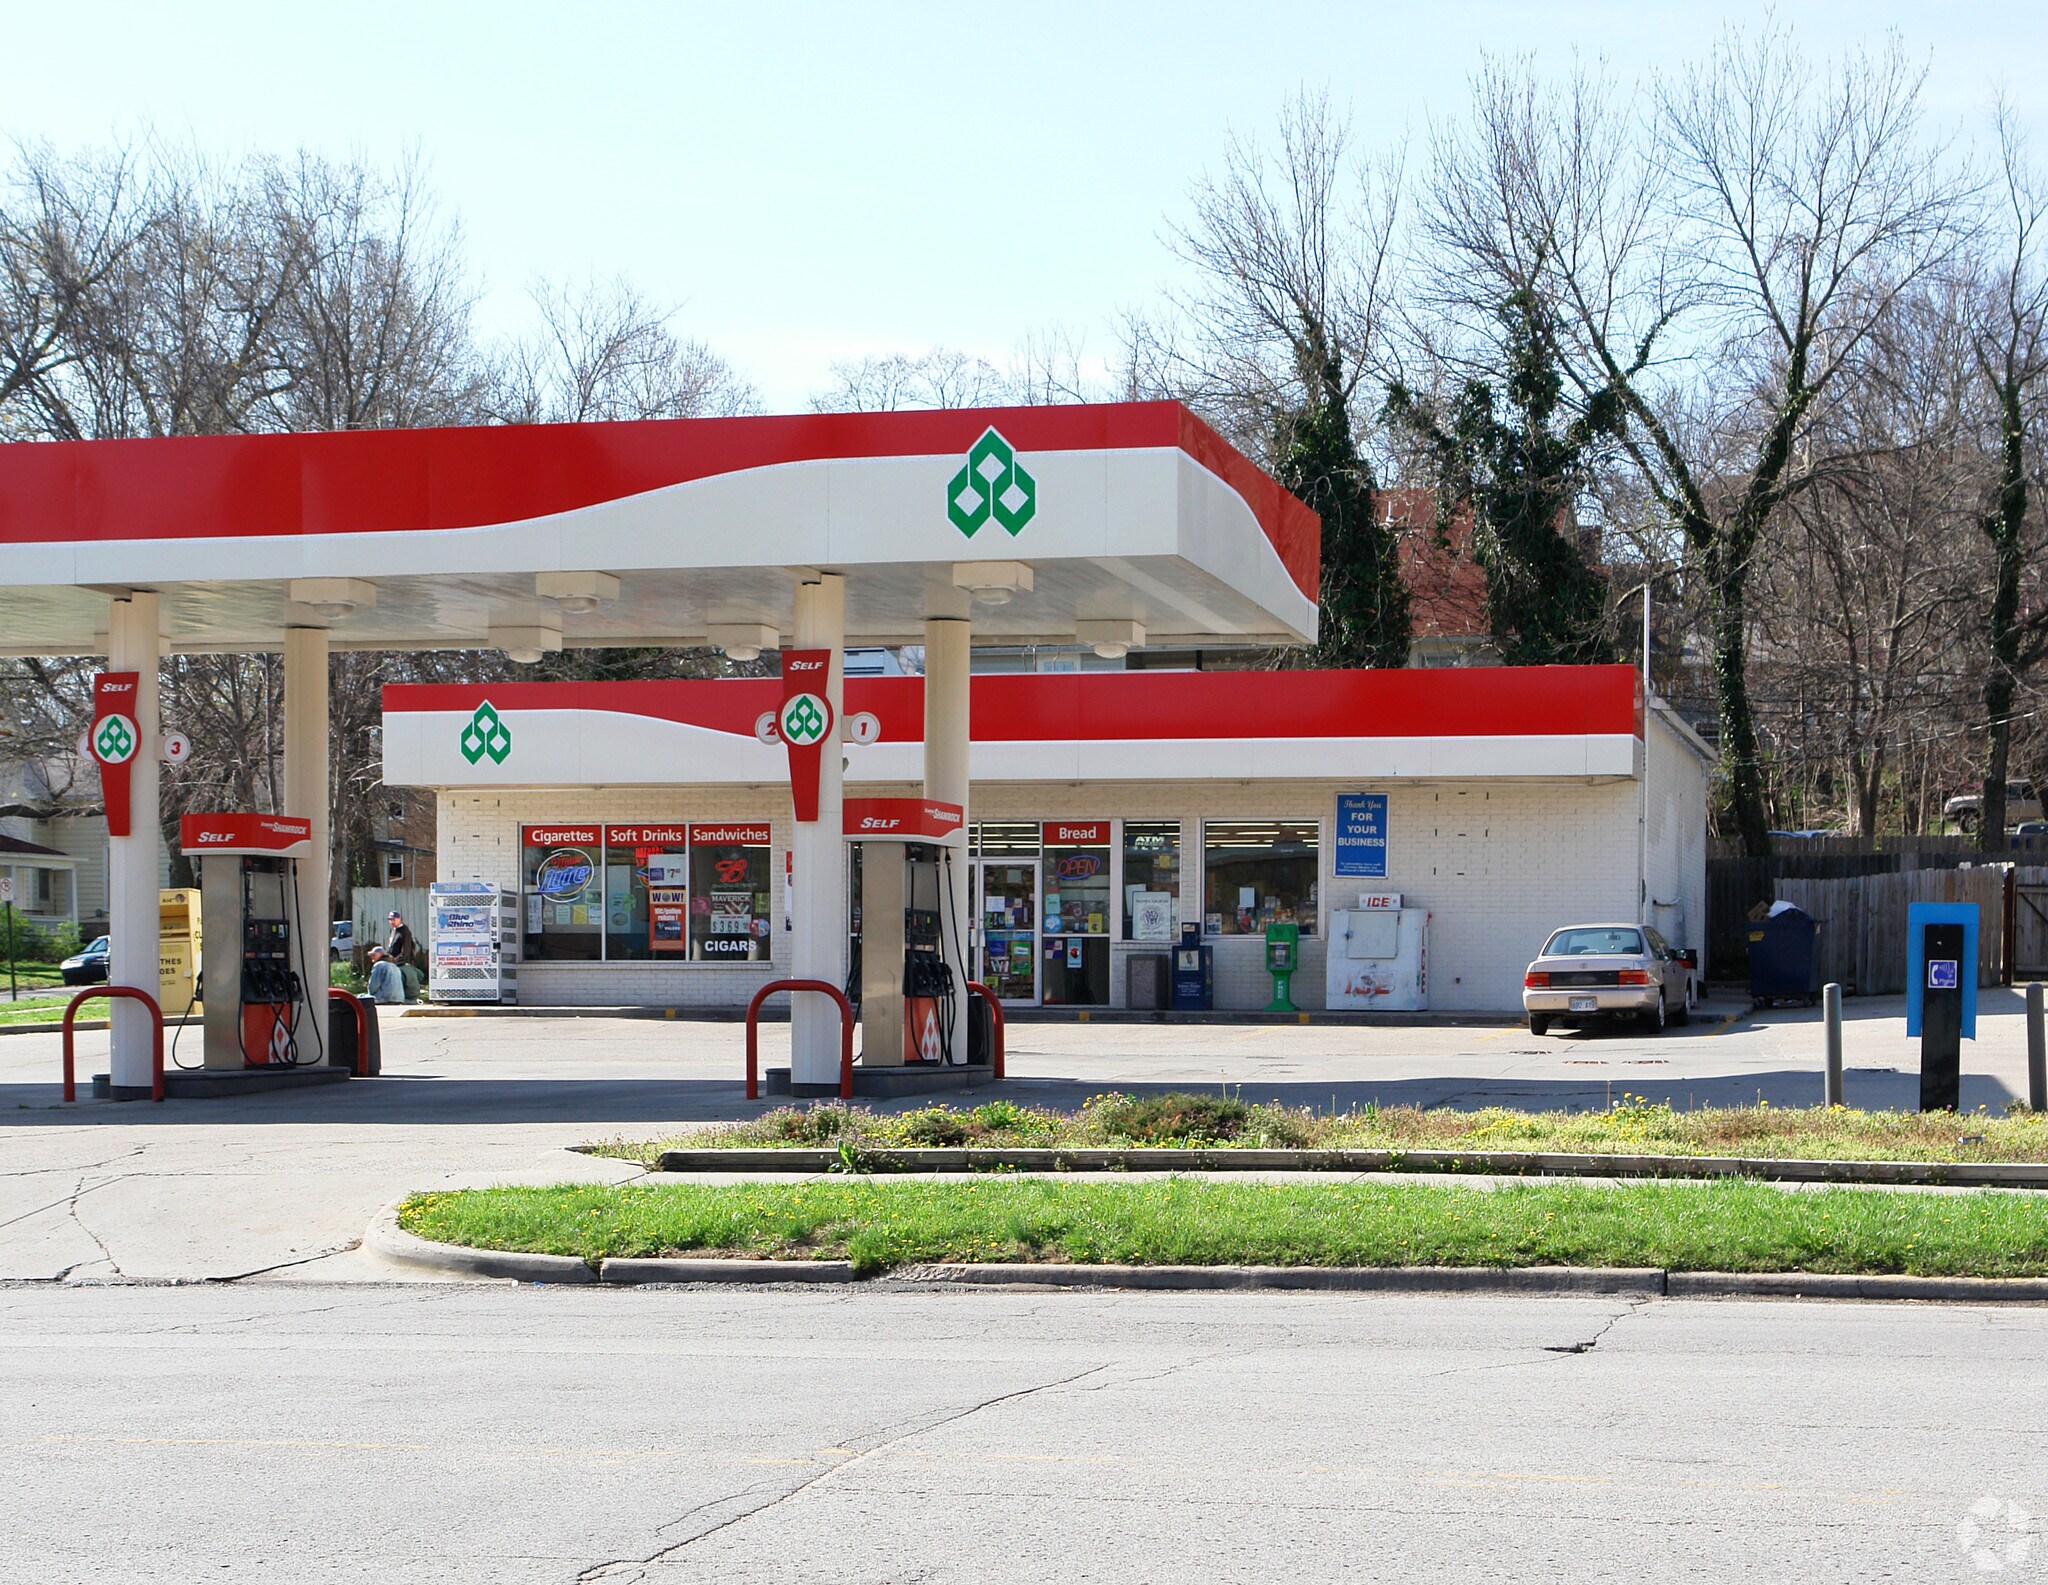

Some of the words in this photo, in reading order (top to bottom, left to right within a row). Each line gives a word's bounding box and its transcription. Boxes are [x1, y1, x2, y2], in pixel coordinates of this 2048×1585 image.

[789, 661, 823, 671] SELF
[101, 683, 133, 692] SELF
[765, 722, 779, 736] 2
[860, 722, 868, 736] 1
[171, 742, 181, 755] 3
[1367, 800, 1382, 810] You
[860, 817, 900, 829] SELF
[1351, 812, 1373, 822] FOR
[611, 829, 638, 842] Soft
[643, 829, 682, 841] Drinks
[693, 828, 769, 841] Sandwiches
[1059, 826, 1097, 839] Bread
[1347, 825, 1377, 834] YOUR
[198, 832, 235, 843] SELF
[531, 830, 594, 843] Cigarettes
[1338, 837, 1385, 847] BUSINESS
[1058, 858, 1097, 875] OPEN
[1367, 897, 1390, 907] ICE
[704, 940, 757, 952] CIGARS
